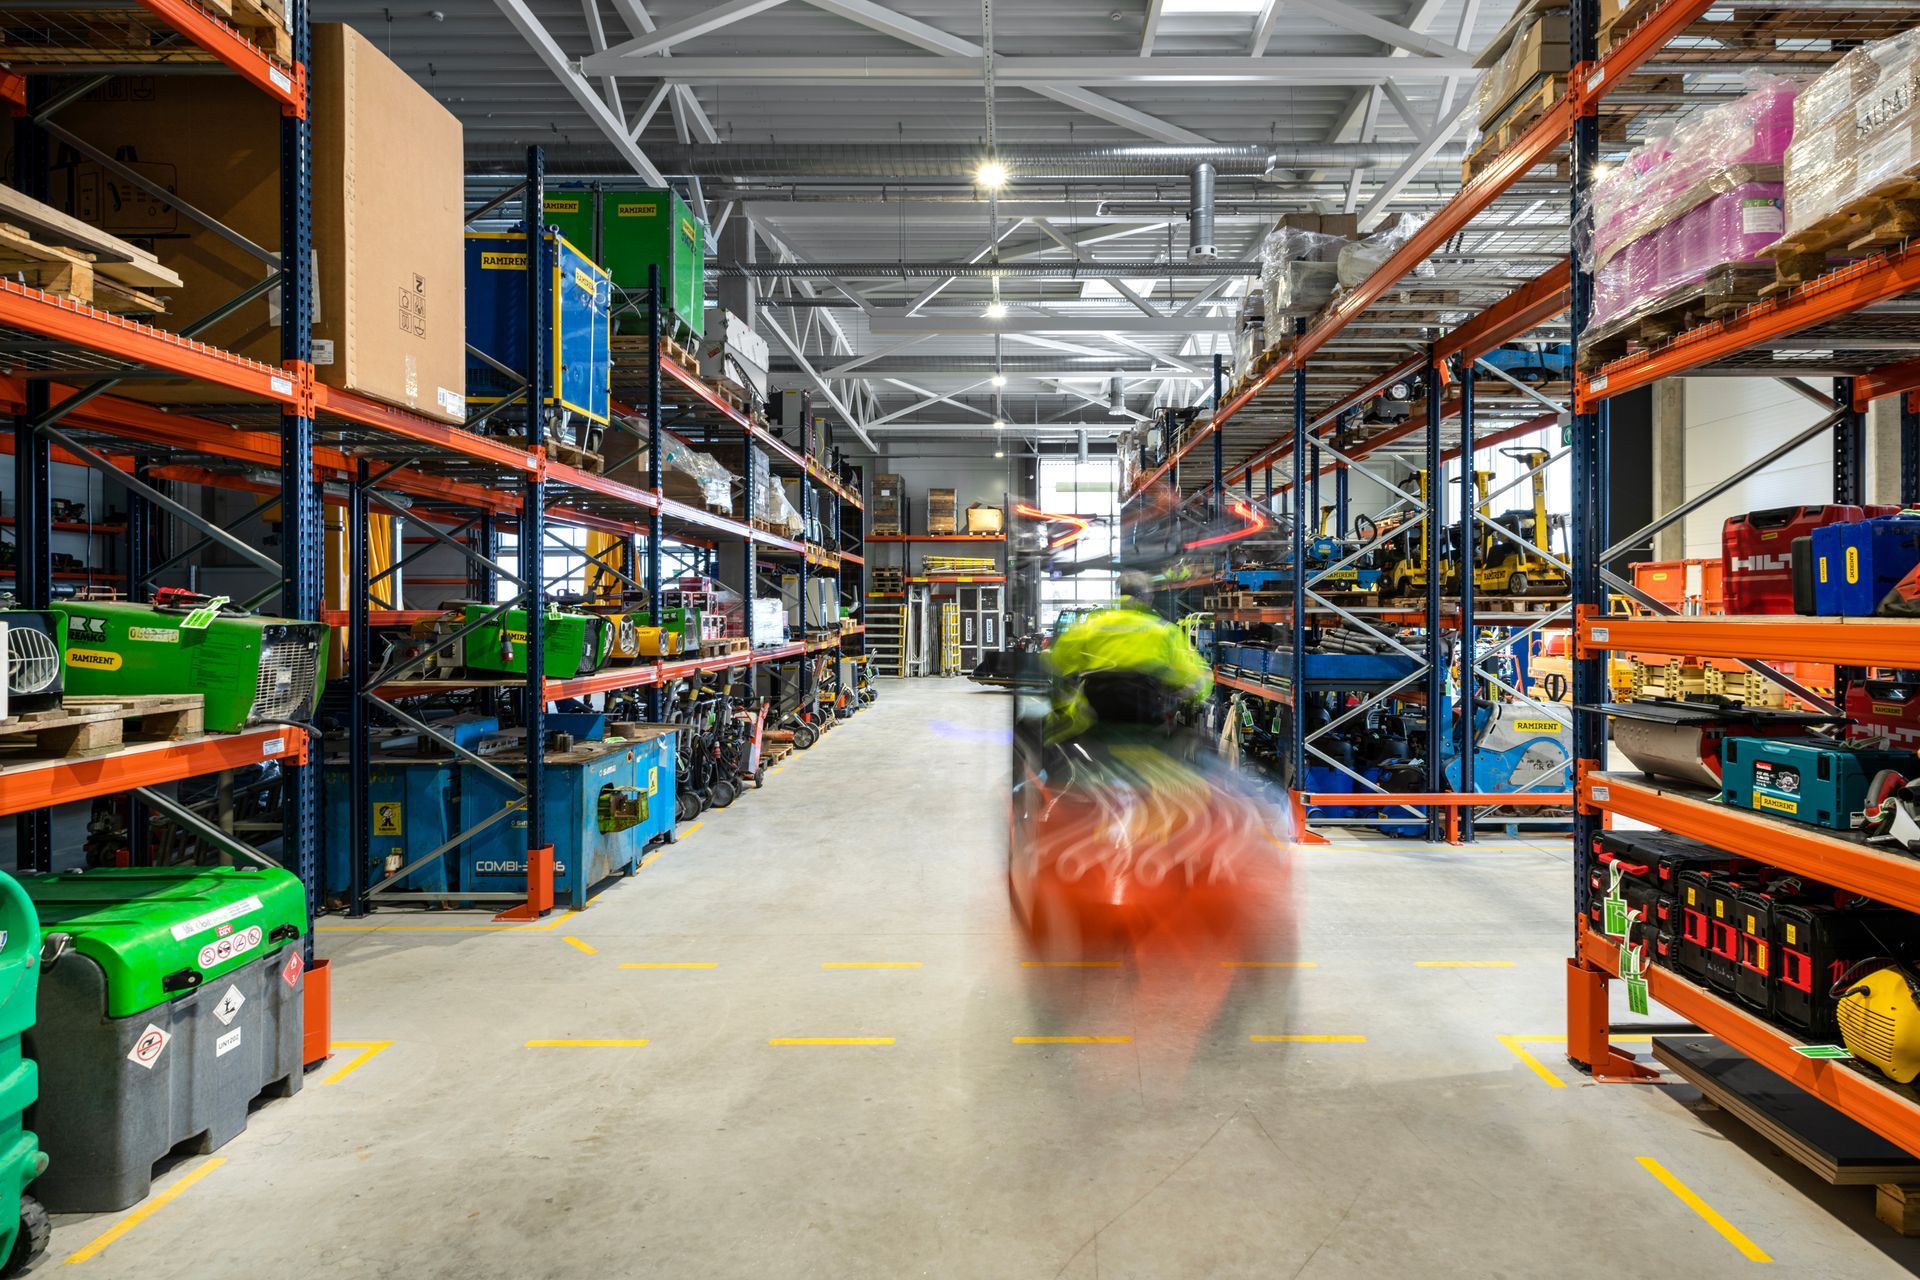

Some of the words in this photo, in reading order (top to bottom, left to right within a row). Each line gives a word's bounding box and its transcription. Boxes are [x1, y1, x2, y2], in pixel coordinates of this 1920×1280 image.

[483, 256, 526, 266] RAMIREN
[1731, 553, 1792, 572] HILT
[69, 632, 106, 642] REMKO
[72, 653, 115, 665] RAMIRENT
[1517, 722, 1558, 731] RAMIRENT
[1852, 723, 1920, 744] HILT
[1763, 798, 1795, 811] RAMIRENT
